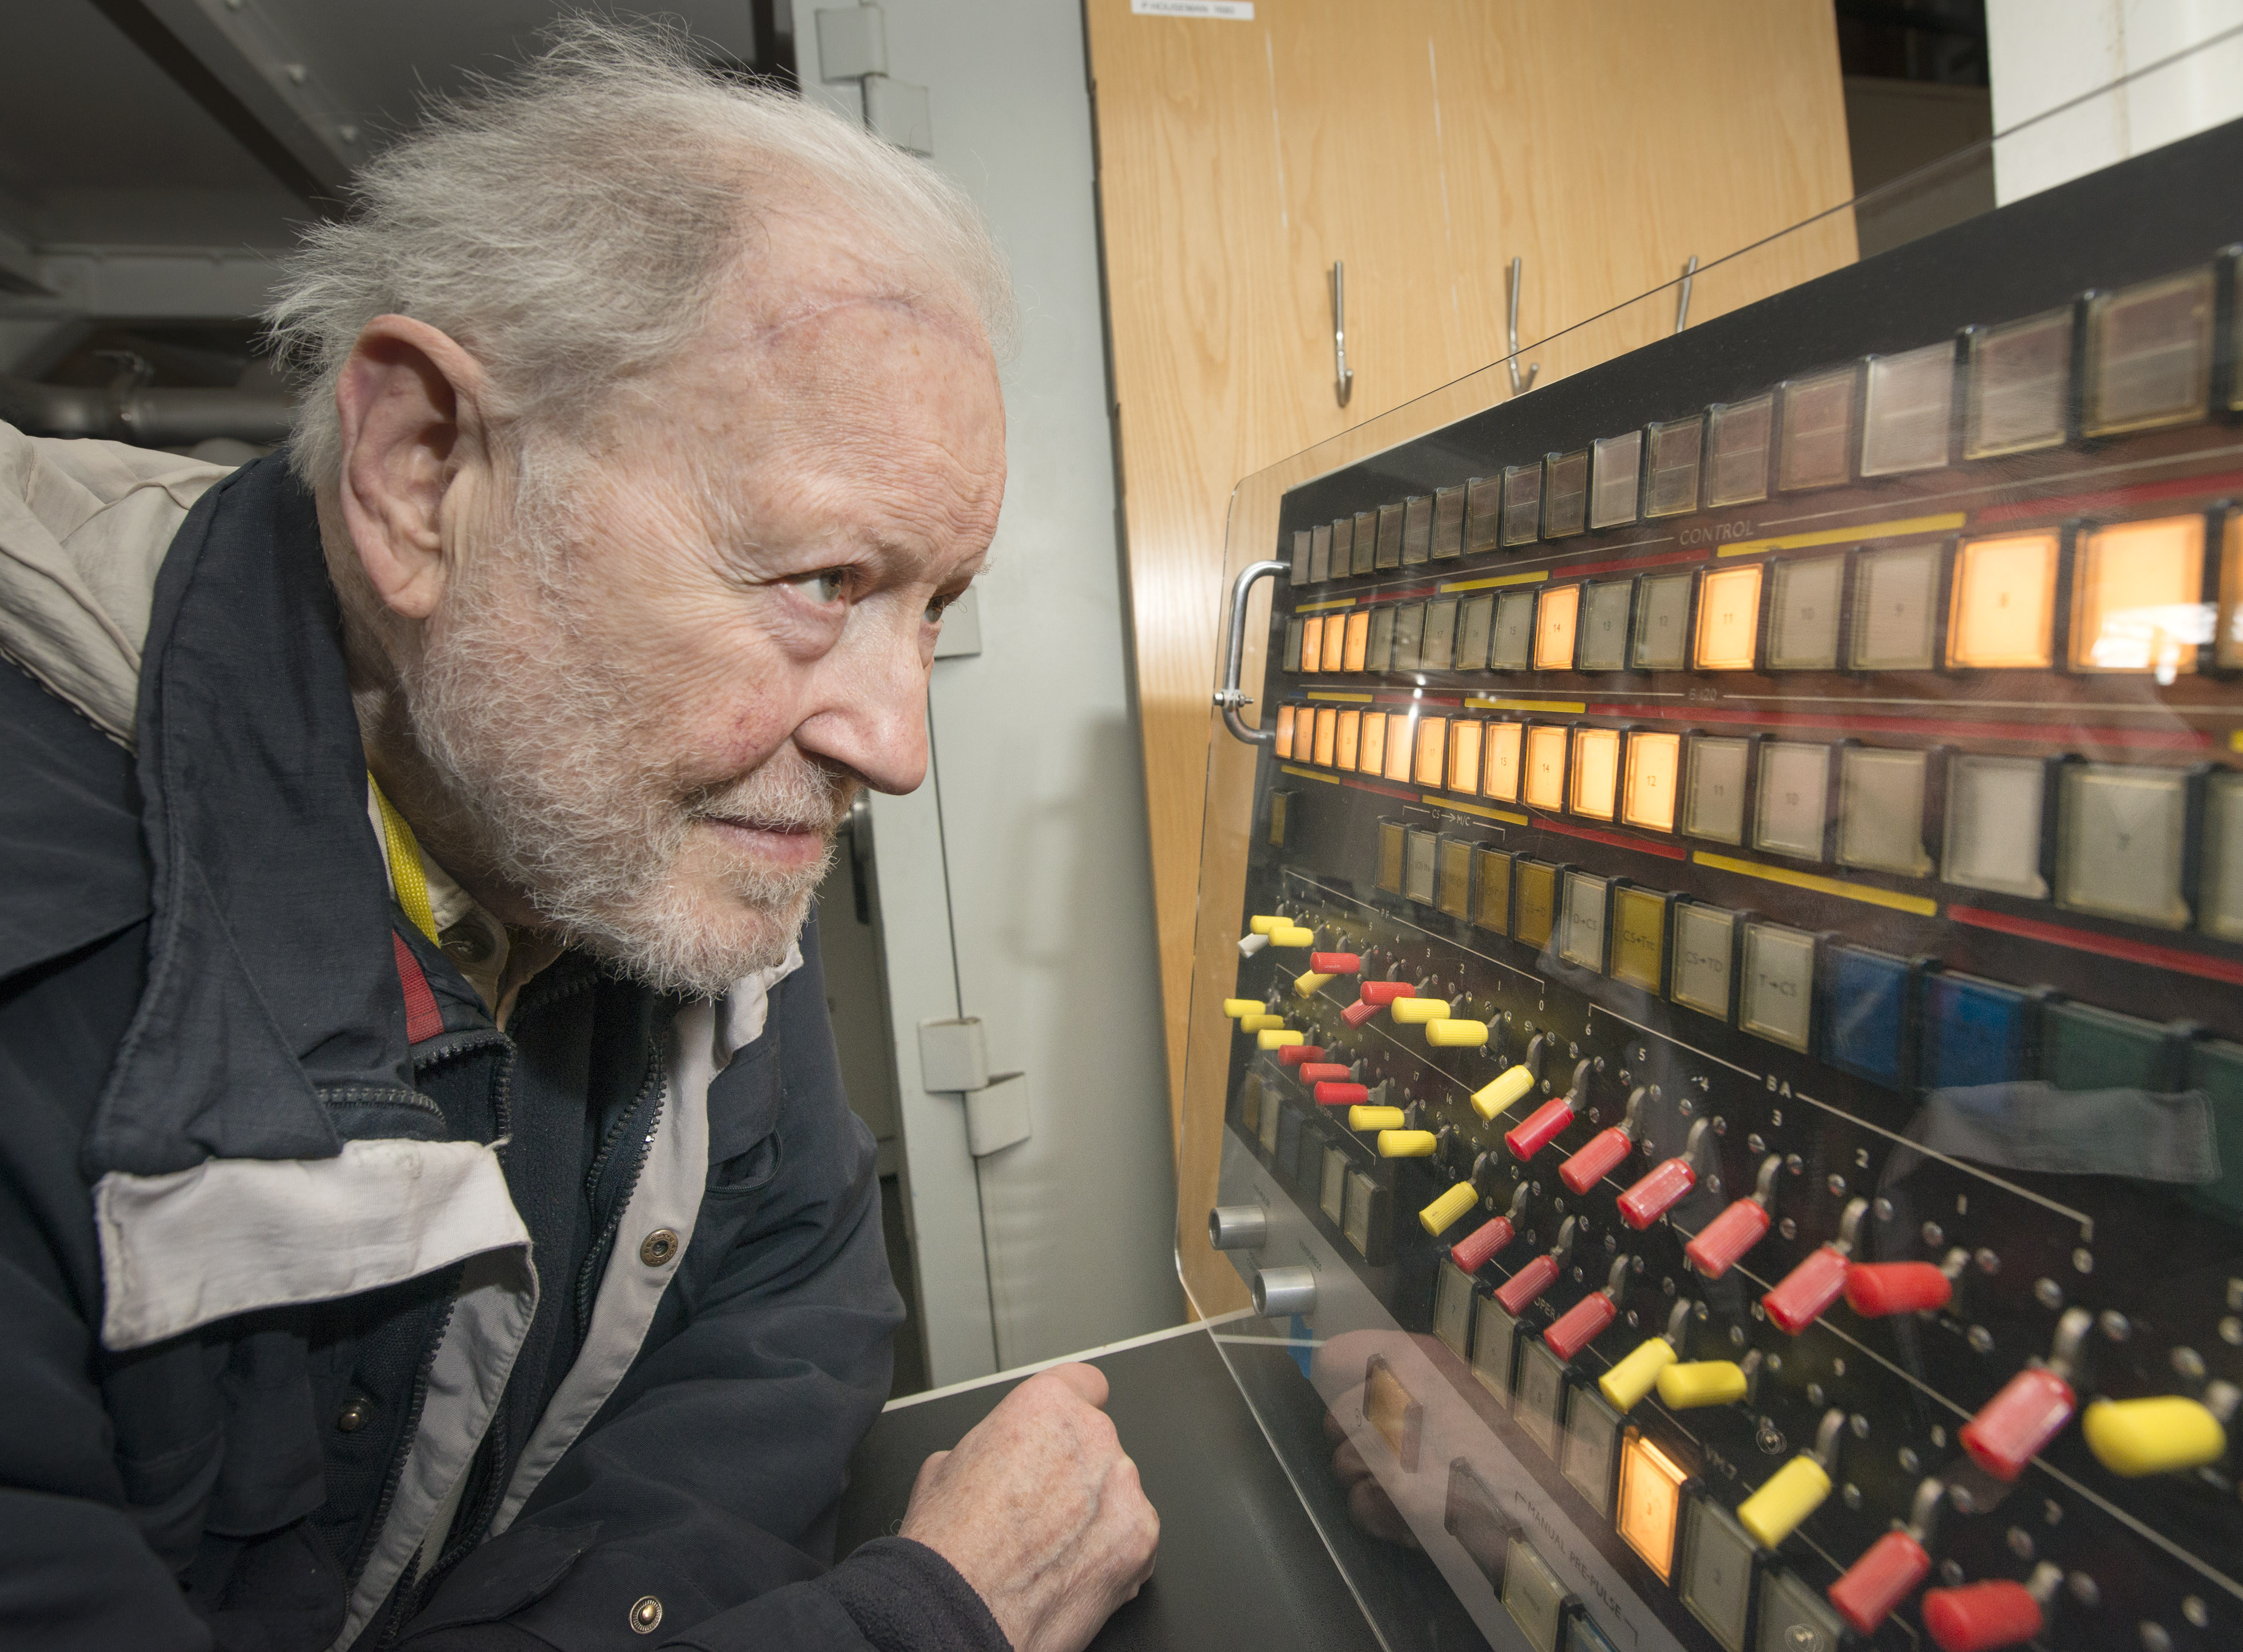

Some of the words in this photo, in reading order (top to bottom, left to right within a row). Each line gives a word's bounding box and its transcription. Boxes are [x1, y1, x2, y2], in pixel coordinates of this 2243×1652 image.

[1680, 519, 1754, 545] CONTROL
[1660, 615, 1668, 626] 12
[1723, 613, 1733, 624] 11
[1509, 626, 1516, 636] 15
[1553, 622, 1560, 632] 14
[1603, 621, 1611, 631] 13
[1437, 630, 1443, 640] 17
[1429, 748, 1435, 756] 17
[1500, 757, 1507, 766] 15
[1543, 763, 1550, 773] 14
[1647, 776, 1656, 787] 12
[1456, 814, 1471, 826] M/C
[1395, 934, 1400, 943] 4
[1426, 948, 1430, 958] 3
[1460, 963, 1464, 974] 2
[1539, 999, 1544, 1011] 0
[1585, 1022, 1591, 1035] 6
[1384, 1050, 1389, 1062] 18
[1638, 1047, 1646, 1062] 5
[1413, 1070, 1420, 1082] 17
[1446, 1093, 1452, 1105] 16
[1771, 1109, 1783, 1127] 3
[1482, 1118, 1489, 1130] 15
[1855, 1147, 1869, 1169] 2
[1528, 1501, 1566, 1554] MANUAL
